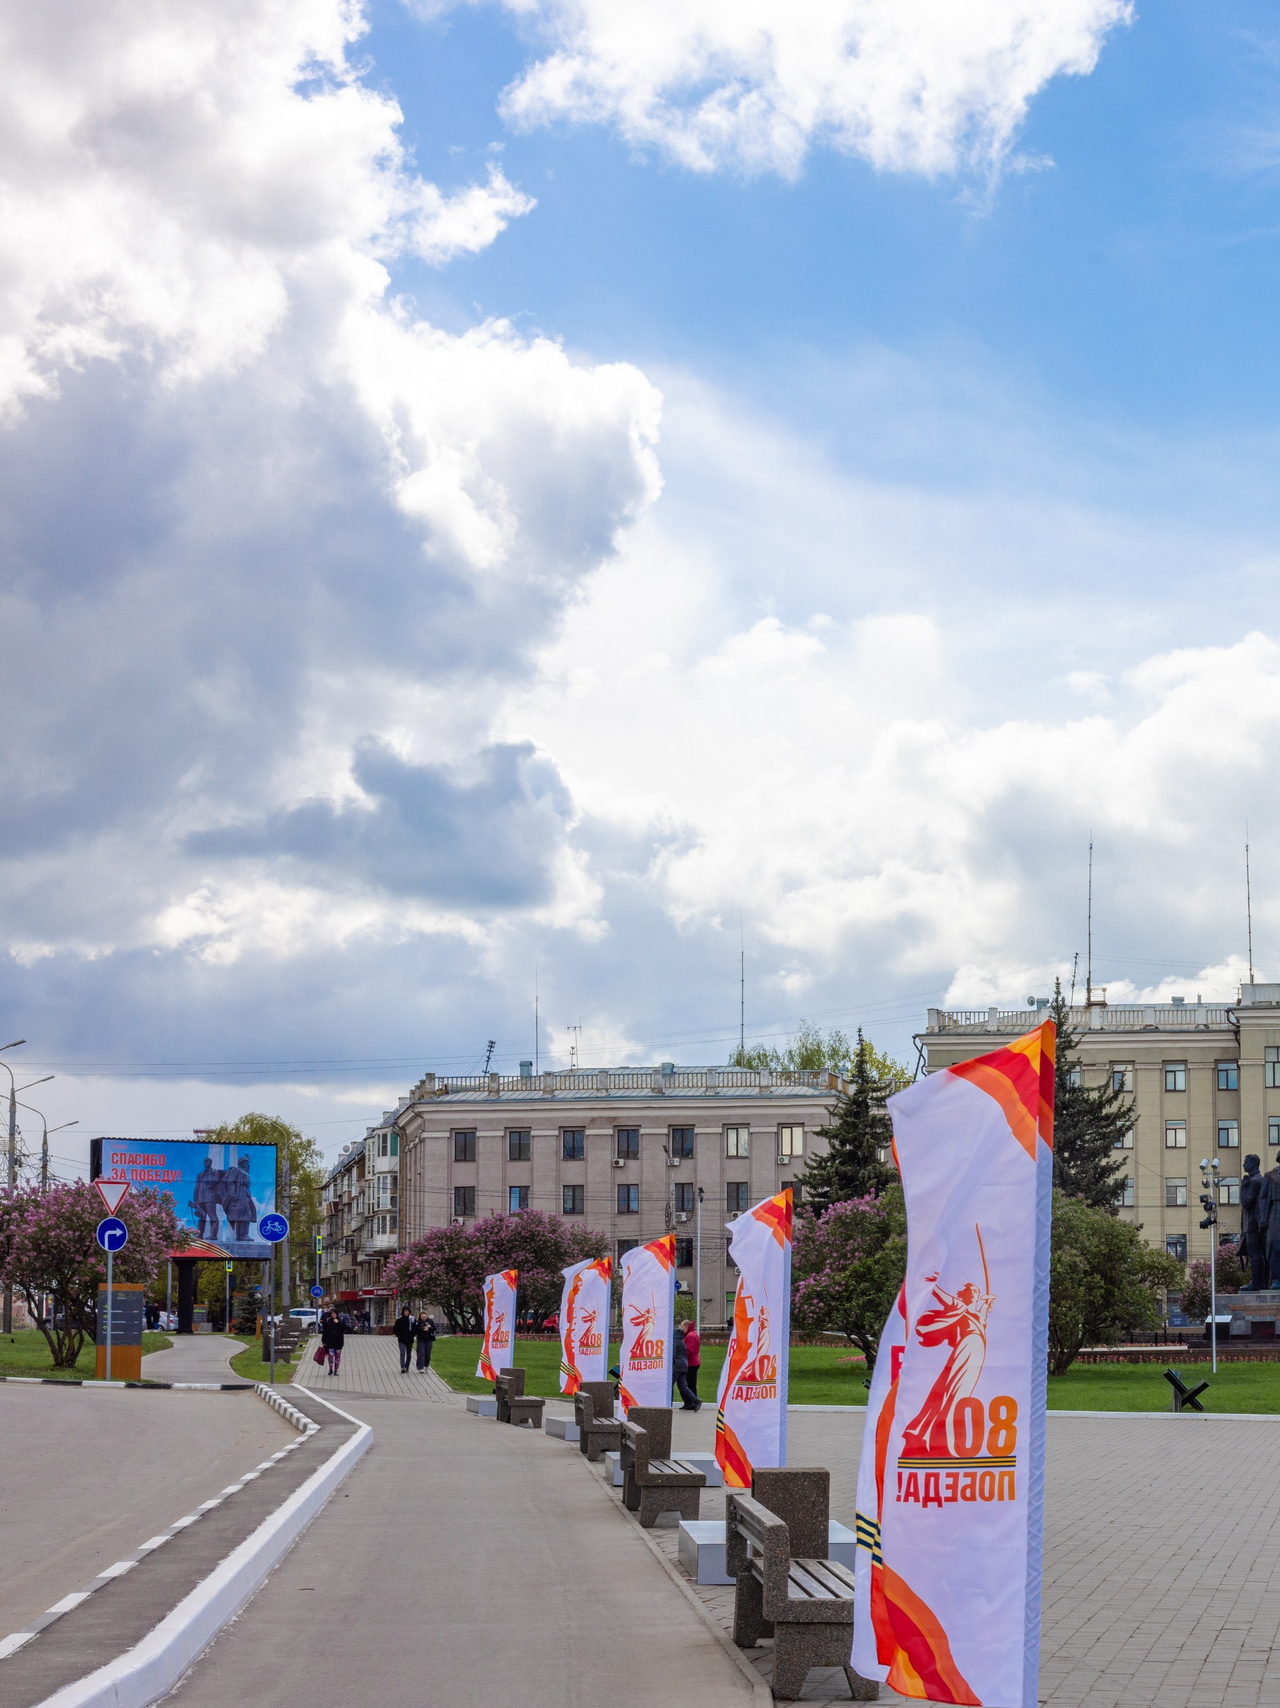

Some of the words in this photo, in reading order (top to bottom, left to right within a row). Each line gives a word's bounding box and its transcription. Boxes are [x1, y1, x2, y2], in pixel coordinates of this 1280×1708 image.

[111, 1152, 166, 1167] СПАСИБО
[111, 1168, 127, 1180] ЗА
[130, 1168, 182, 1184] ПОБЕДУ!
